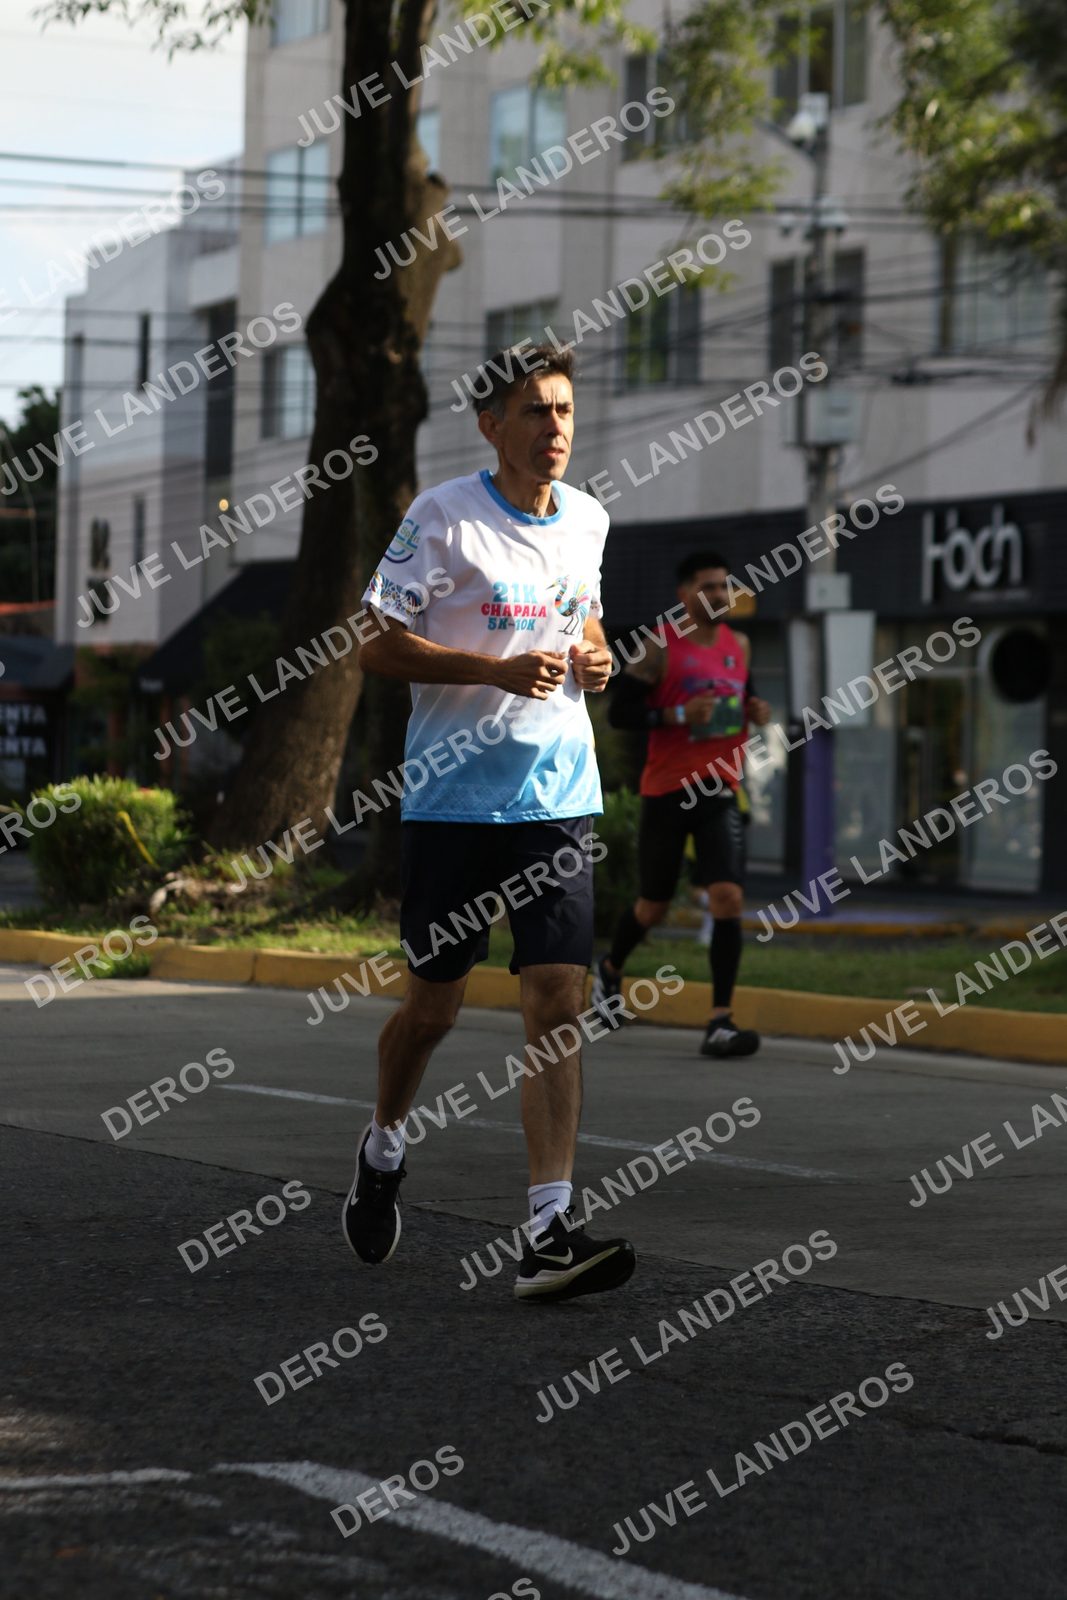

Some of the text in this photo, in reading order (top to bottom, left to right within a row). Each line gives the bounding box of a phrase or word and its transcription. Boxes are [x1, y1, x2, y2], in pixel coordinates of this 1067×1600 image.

[493, 581, 538, 603] 21K
[481, 602, 548, 618] CHAPALA
[487, 617, 536, 631] 5K-10K
